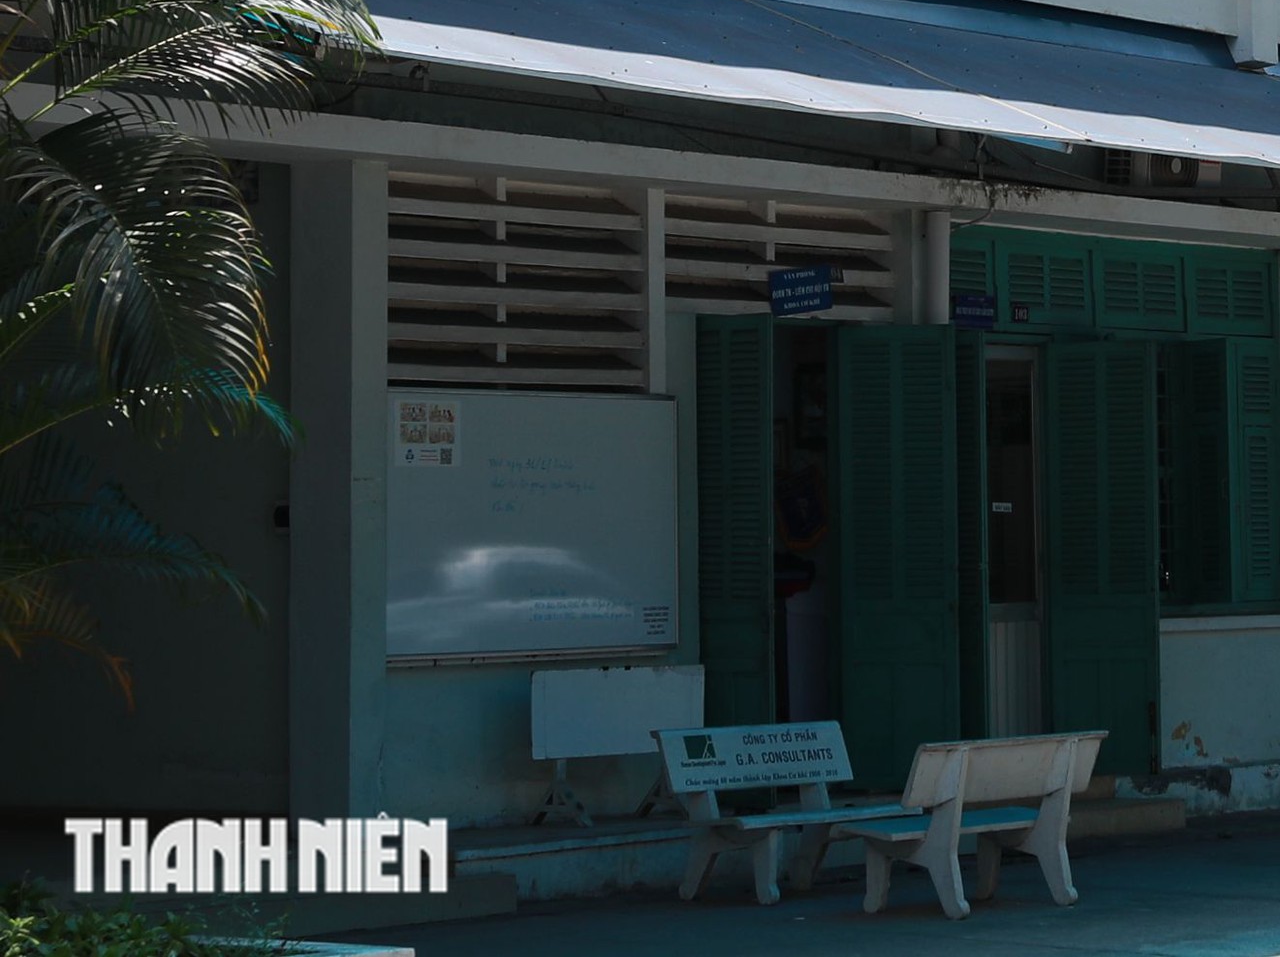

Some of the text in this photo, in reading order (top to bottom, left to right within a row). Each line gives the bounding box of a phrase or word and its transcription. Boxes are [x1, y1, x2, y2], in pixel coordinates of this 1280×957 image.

[742, 728, 818, 745] CÔNG TY CỔ PHẦN
[735, 753, 758, 766] G.A.
[761, 748, 834, 764] CONSULTANTS
